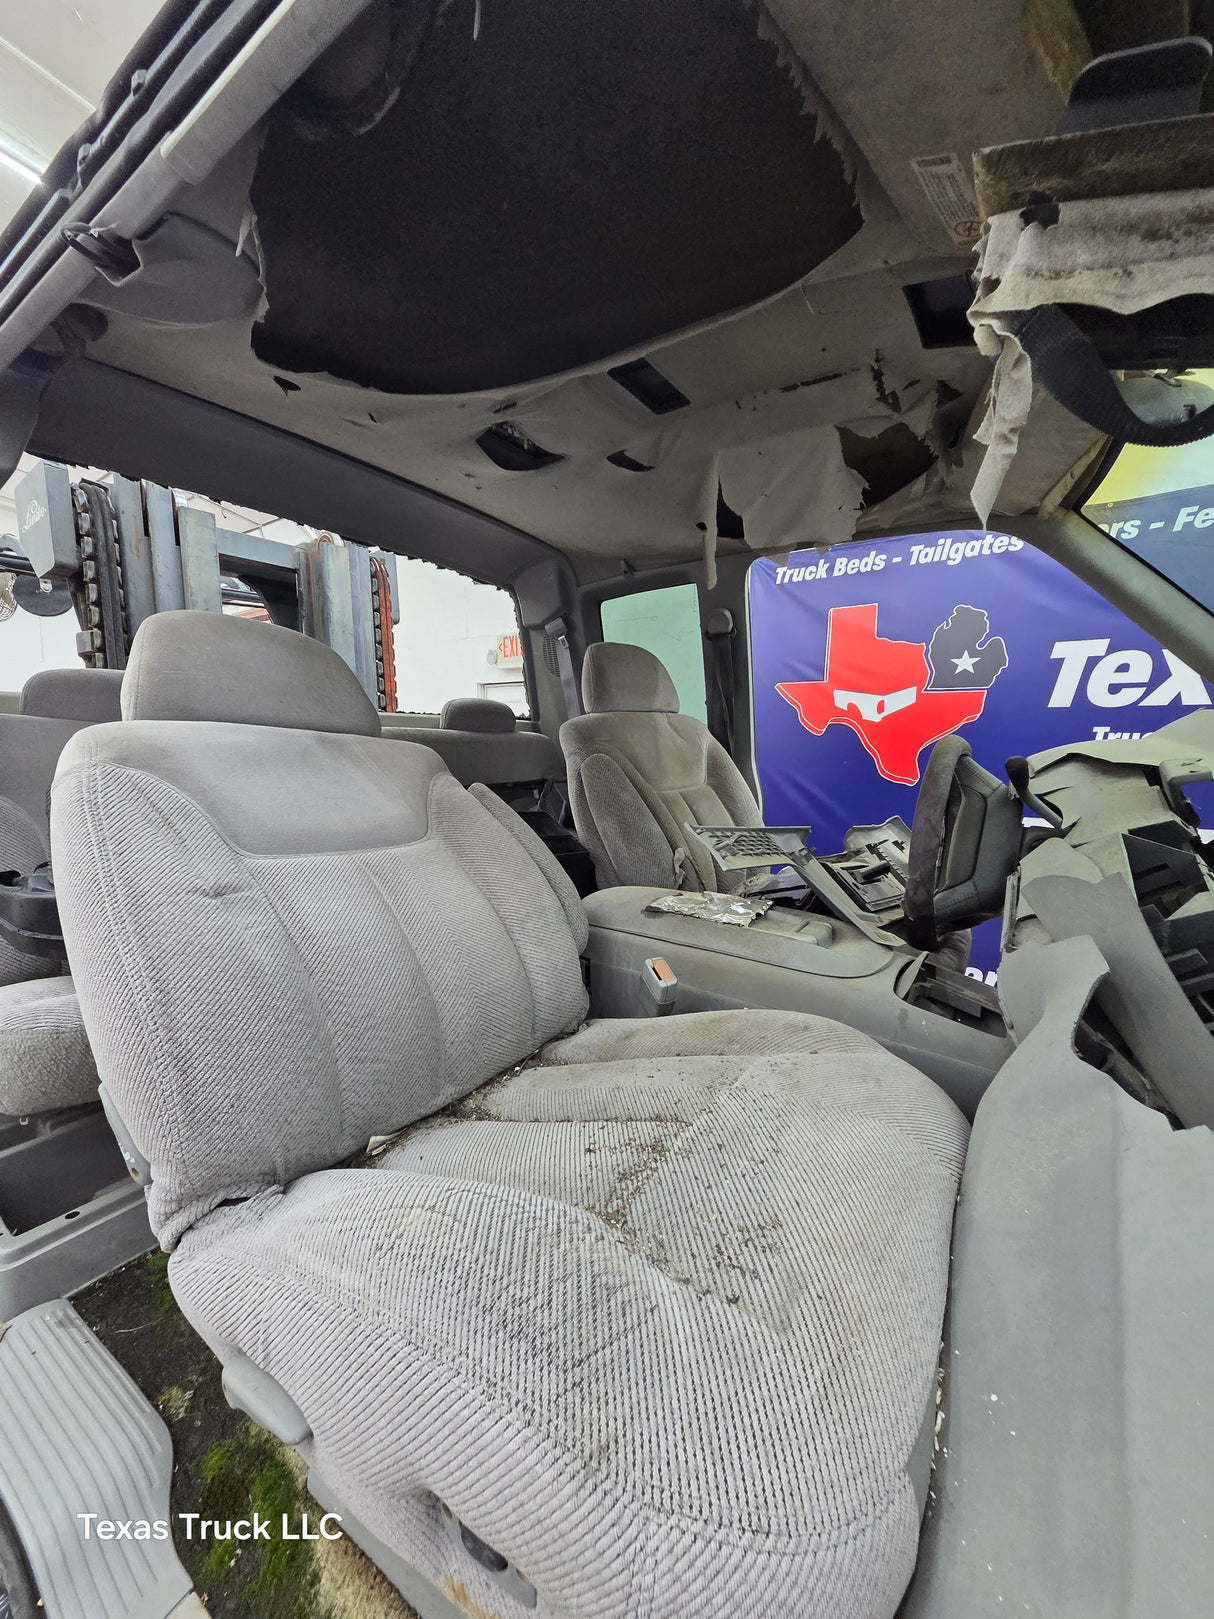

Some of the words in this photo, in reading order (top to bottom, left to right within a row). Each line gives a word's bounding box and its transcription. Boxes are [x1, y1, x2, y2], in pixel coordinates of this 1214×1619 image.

[775, 559, 830, 585] Truck
[832, 550, 888, 577] Beds
[909, 534, 1025, 566] Tailgates
[503, 635, 523, 658] EXI
[1047, 638, 1212, 708] Tex
